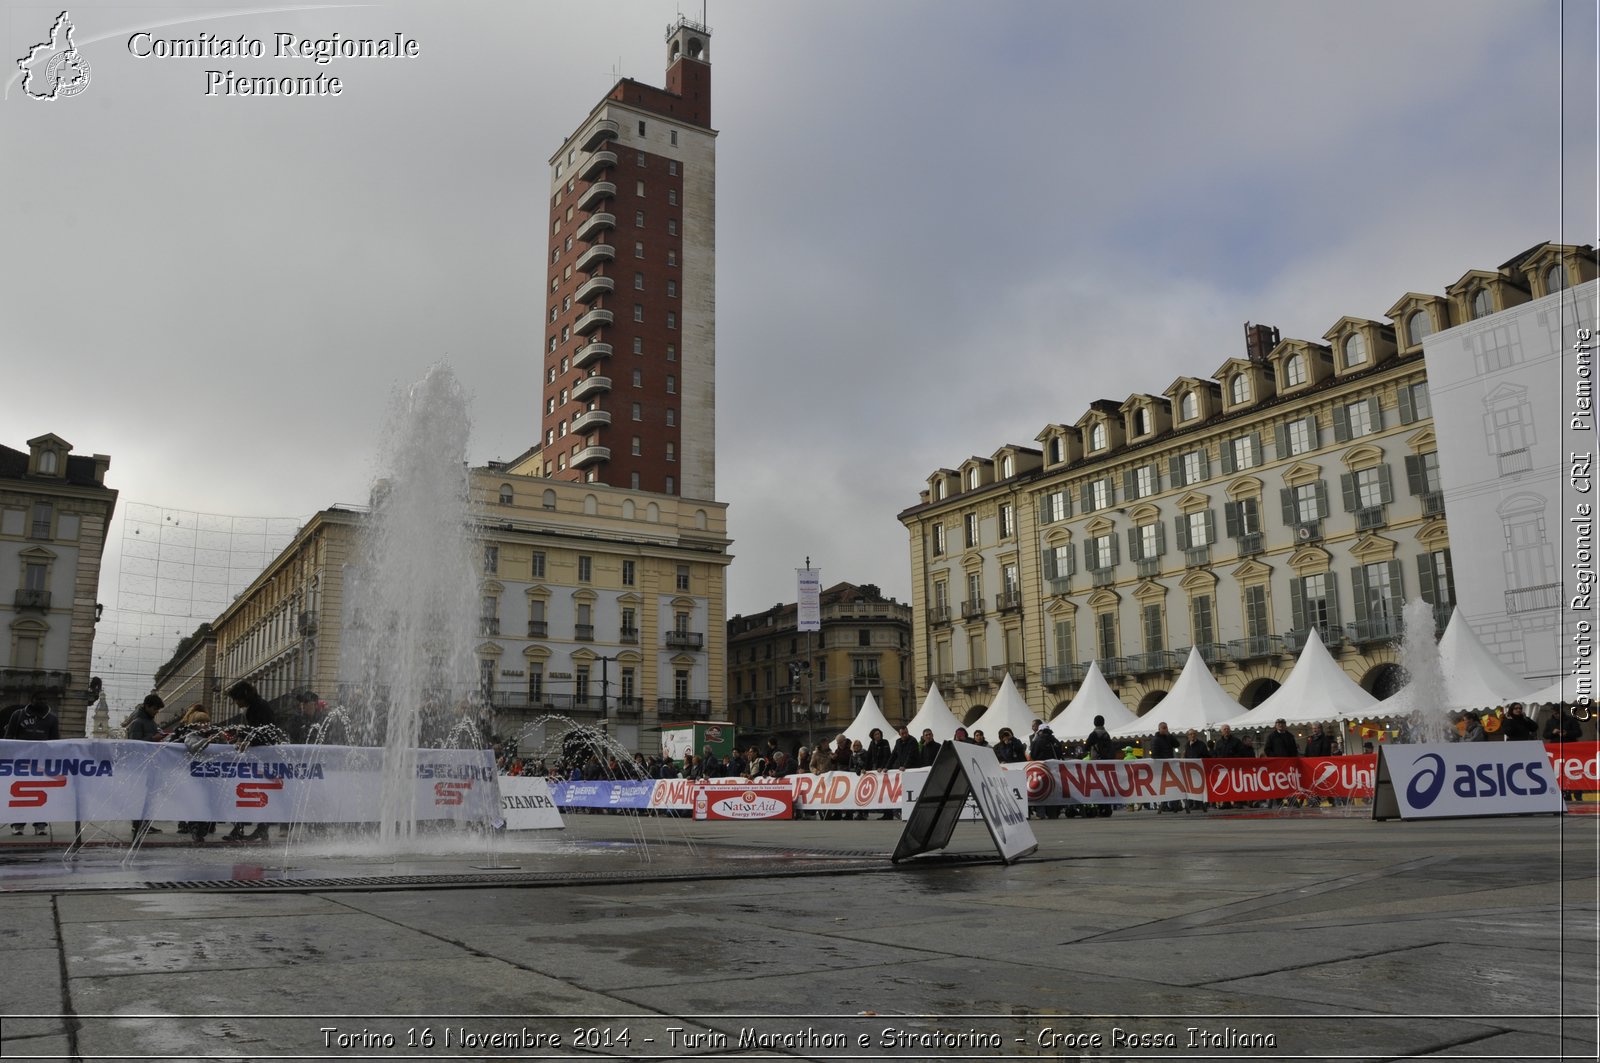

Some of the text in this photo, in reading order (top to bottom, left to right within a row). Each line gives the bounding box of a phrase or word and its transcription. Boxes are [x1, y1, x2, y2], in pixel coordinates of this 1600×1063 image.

[0, 758, 112, 777] SELUNGA
[190, 761, 324, 780] ESSELUNGA
[1231, 766, 1301, 793] UniCredit
